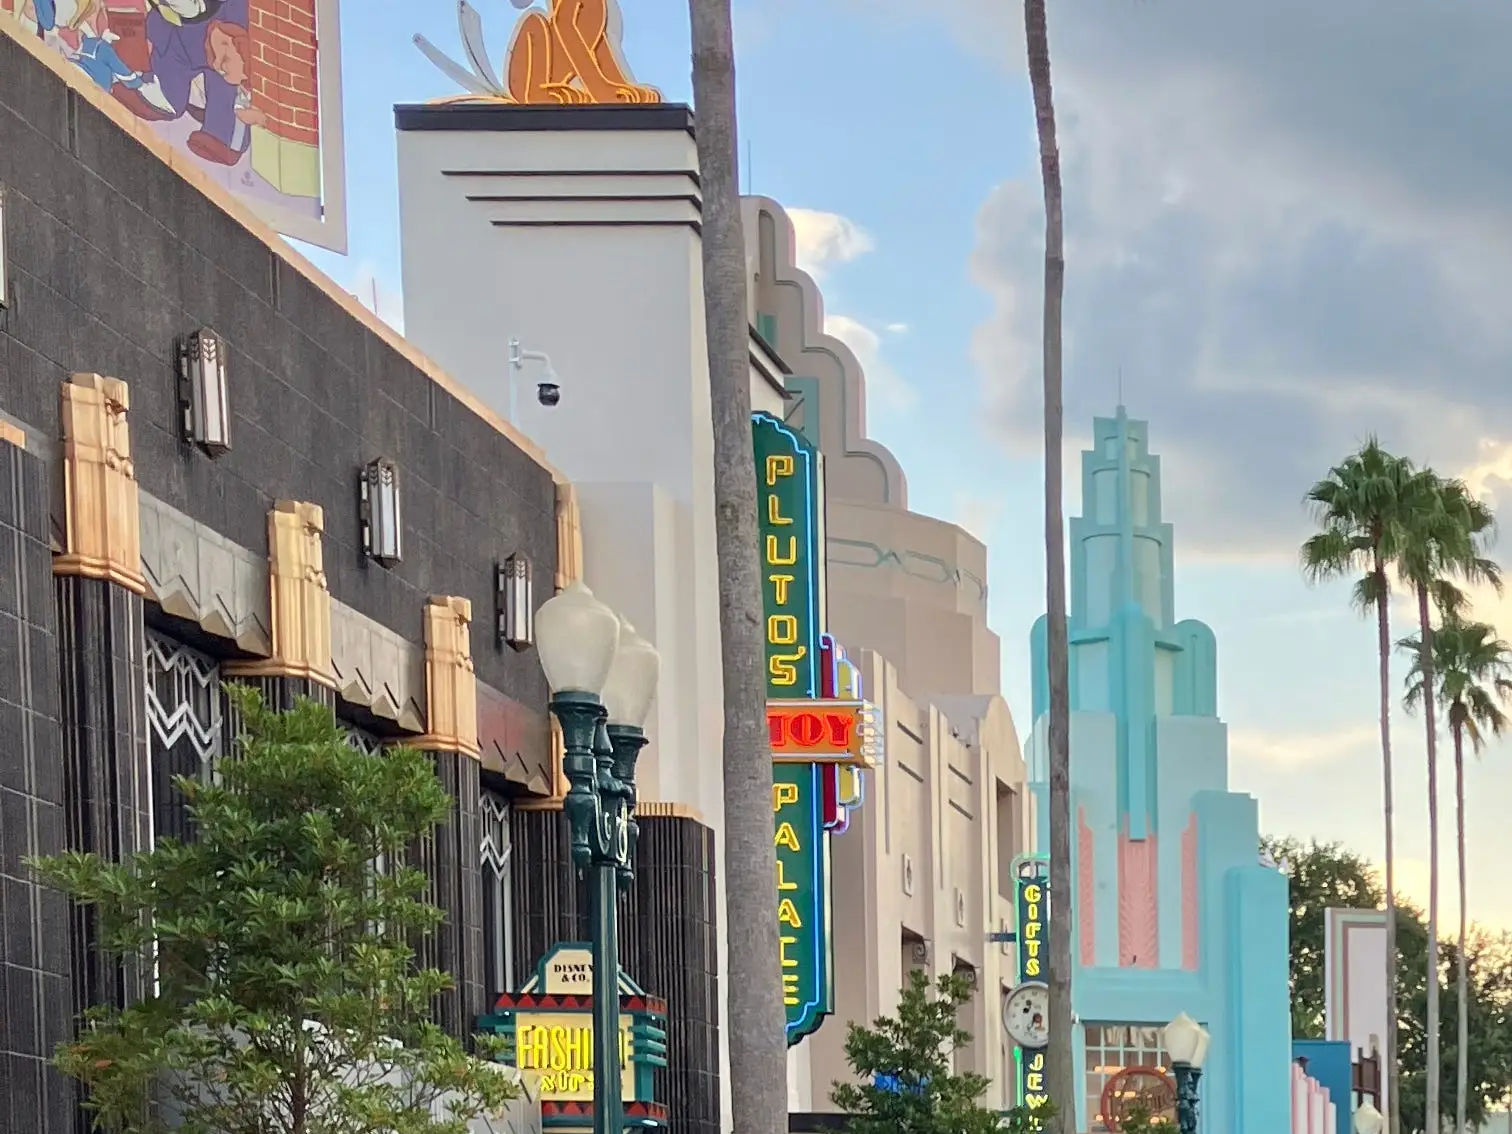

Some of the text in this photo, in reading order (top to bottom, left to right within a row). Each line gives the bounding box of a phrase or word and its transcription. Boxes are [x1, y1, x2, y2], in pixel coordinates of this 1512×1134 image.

[766, 455, 807, 686] PLUTO'S
[766, 712, 852, 748] TOY
[772, 783, 802, 1006] PALACE
[1024, 884, 1042, 977] GIFTS
[561, 974, 590, 983] & CO.
[518, 1026, 625, 1071] FASHI
